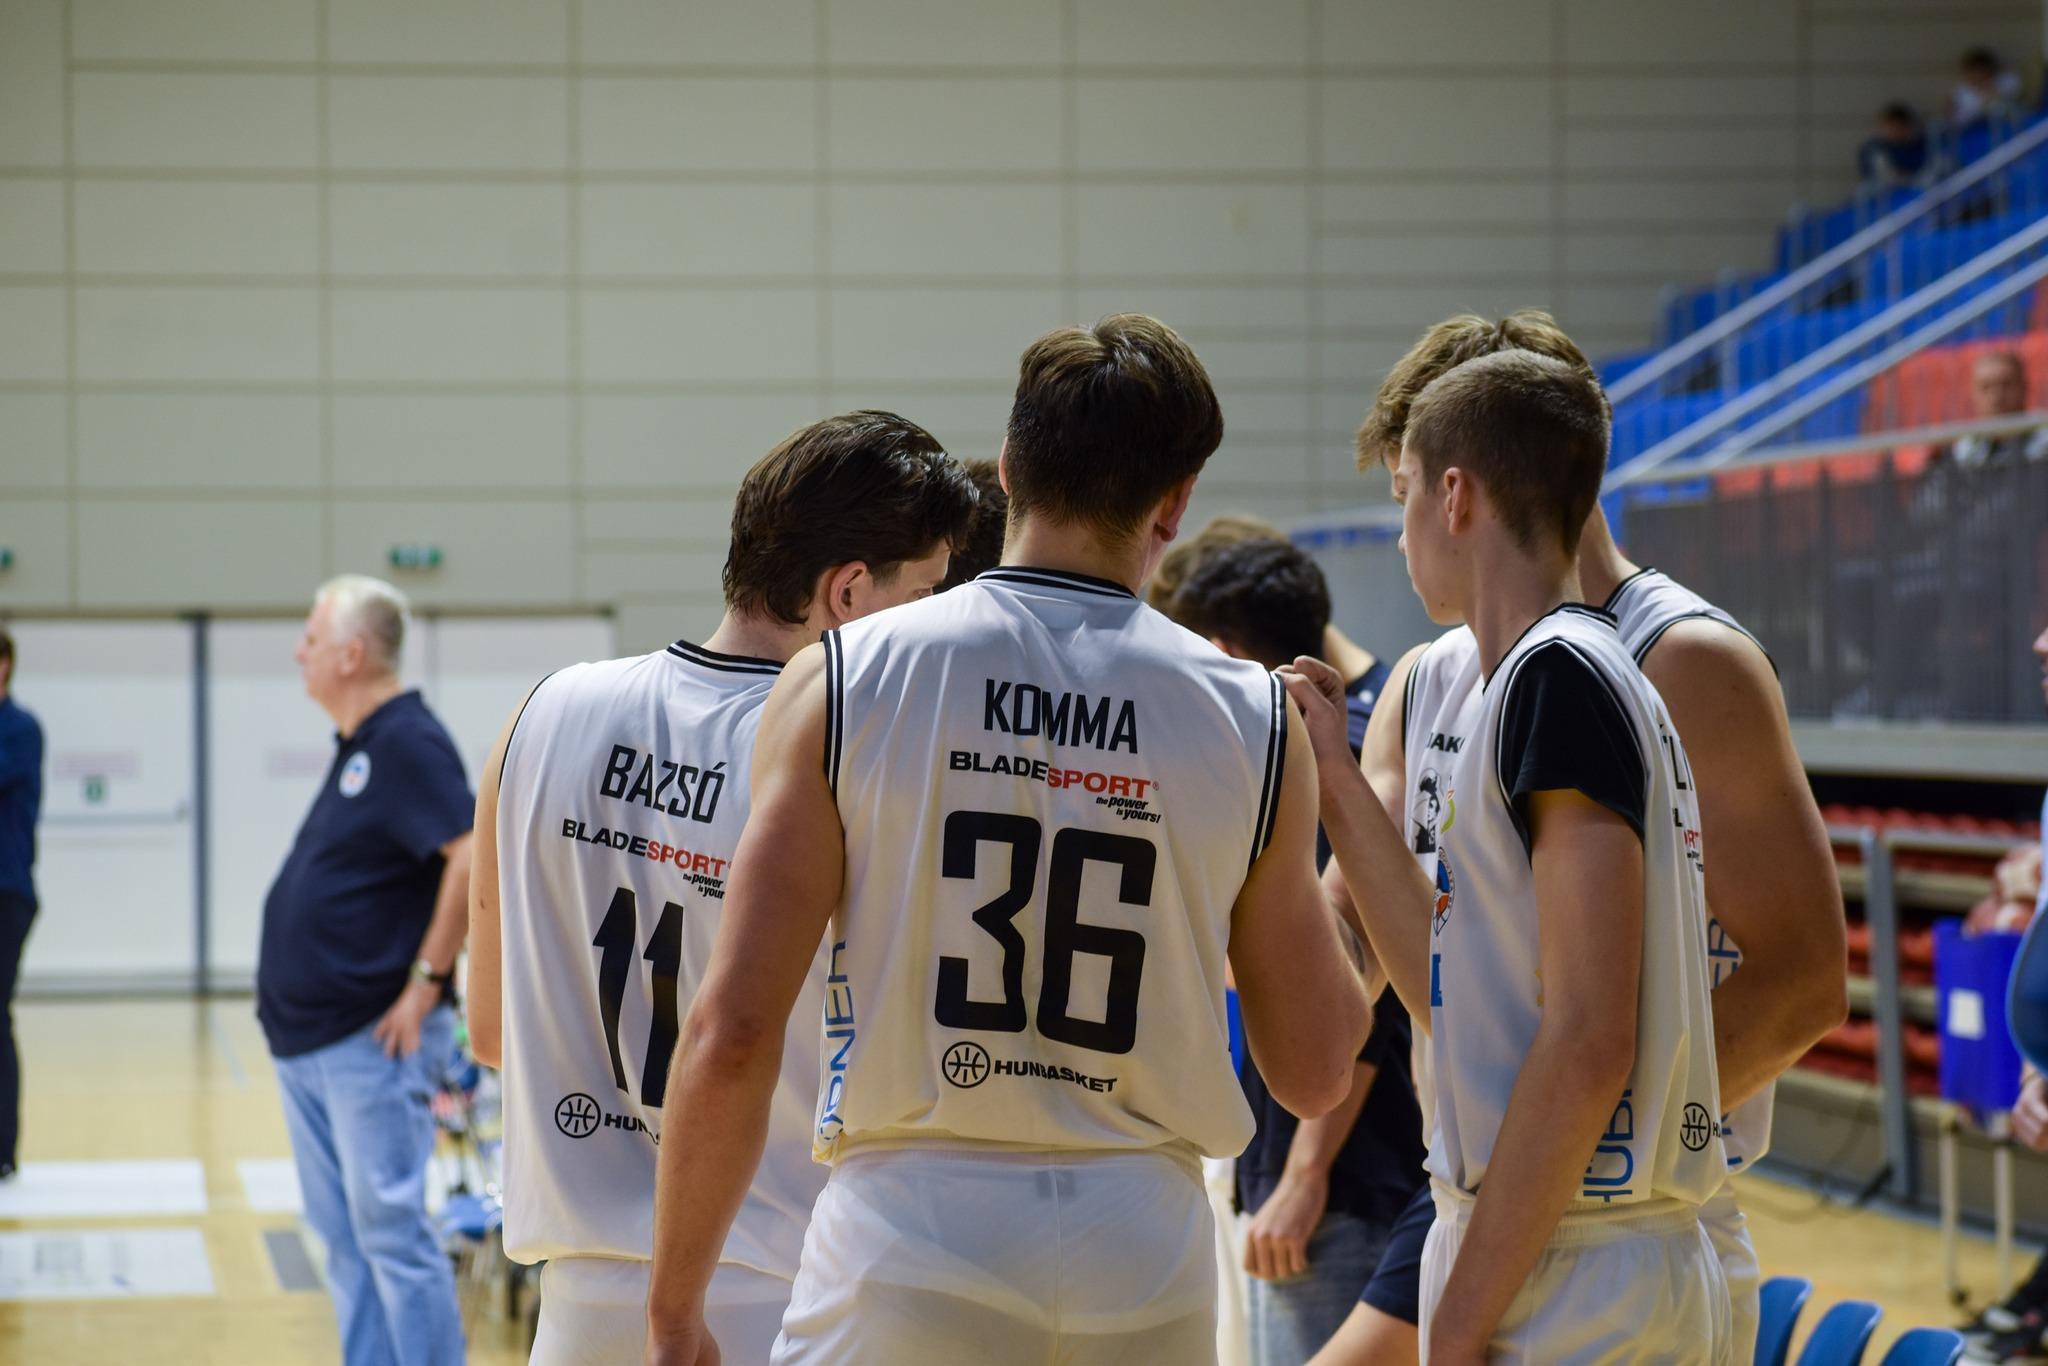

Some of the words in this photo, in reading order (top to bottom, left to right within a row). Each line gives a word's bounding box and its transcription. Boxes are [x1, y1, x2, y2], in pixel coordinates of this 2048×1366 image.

[984, 678, 1138, 754] KOMMA
[1427, 732, 1466, 753] AK
[600, 744, 727, 824] BAZSÓ
[1108, 797, 1148, 810] power
[1123, 809, 1161, 824] yours!
[691, 874, 723, 889] power
[703, 886, 725, 899] your
[935, 810, 1157, 1054] 36
[592, 887, 684, 1108] 11
[994, 1060, 1117, 1092] HUNBASKET
